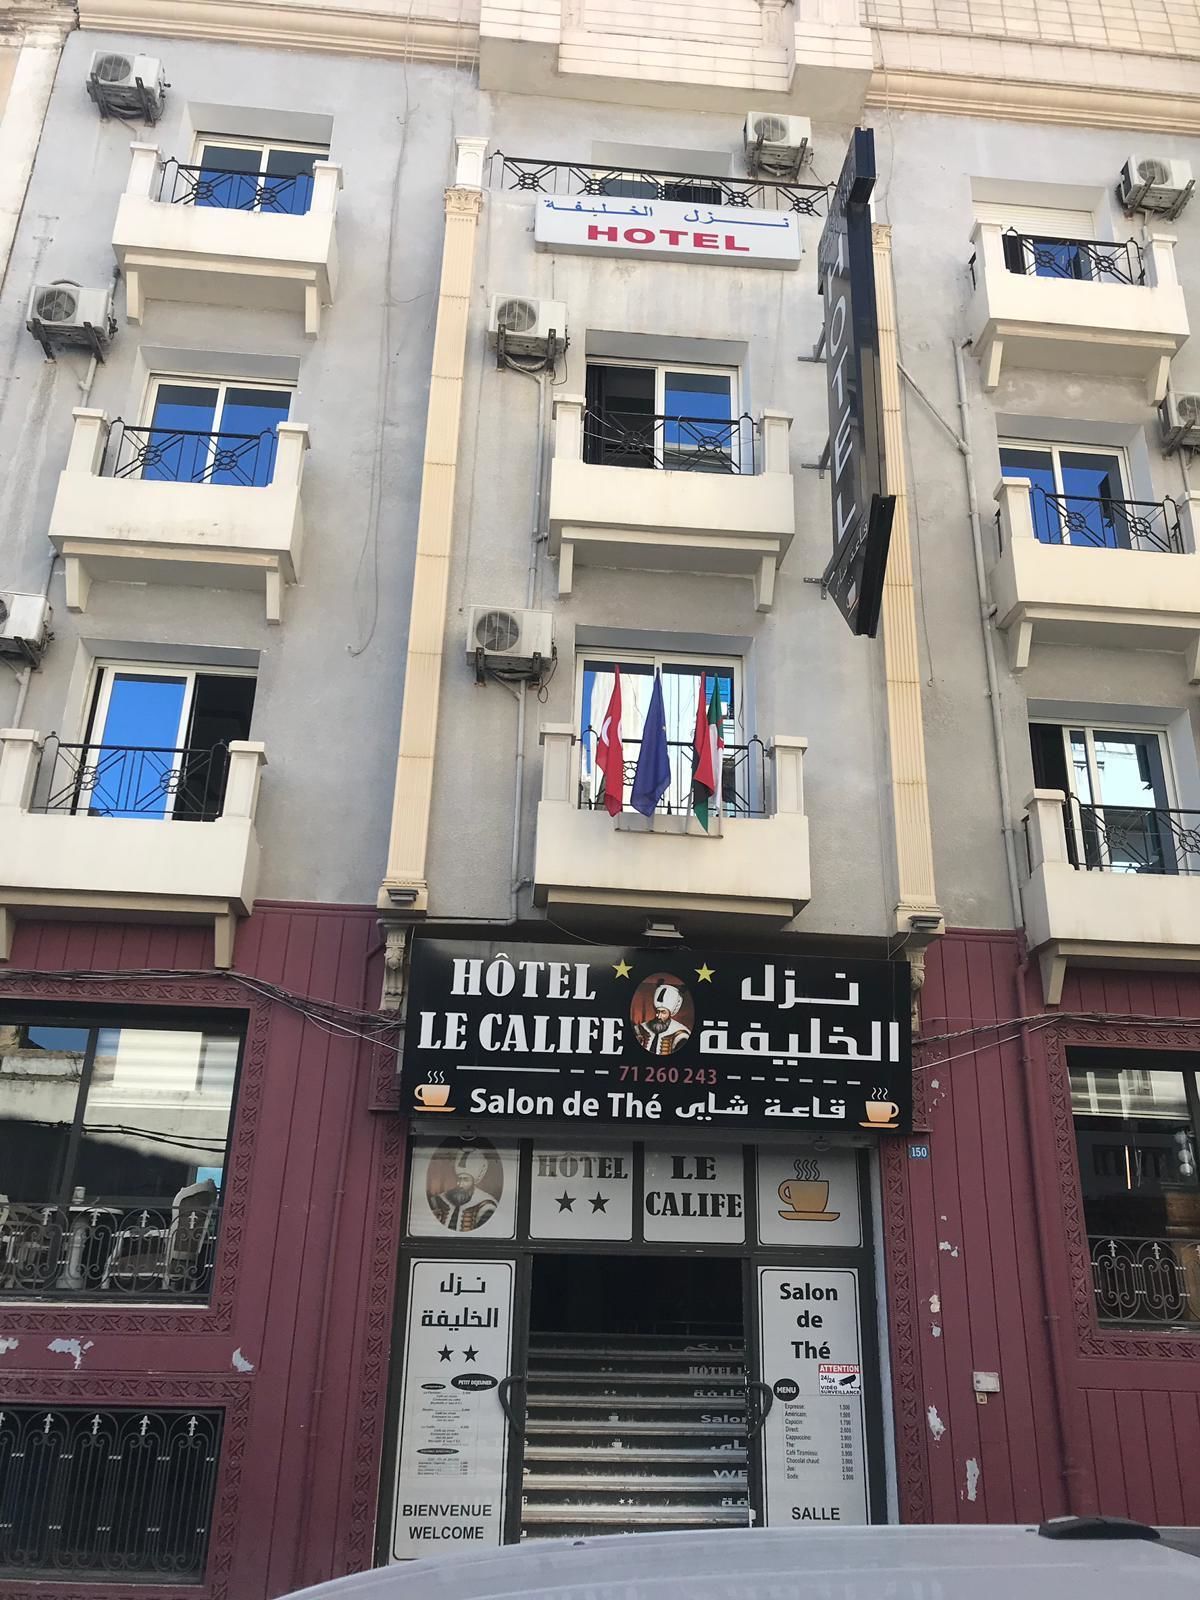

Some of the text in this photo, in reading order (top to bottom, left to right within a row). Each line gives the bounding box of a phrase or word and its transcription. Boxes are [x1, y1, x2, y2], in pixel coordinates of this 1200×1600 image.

[543, 199, 790, 228] نزل الخليفة
[587, 224, 750, 252] HOTEL
[827, 233, 857, 545] HOTEL
[450, 952, 597, 1000] HÔTEL
[741, 964, 860, 1009] نزل
[417, 1011, 625, 1055] LE CALIFE
[699, 1018, 899, 1066] الخليفة
[619, 1065, 718, 1086] 71 260 243
[469, 1087, 663, 1119] Salon de Thé
[675, 1090, 846, 1121] قاعة شاي
[911, 1147, 927, 1158] 150
[537, 1151, 629, 1180] HÔTEL
[671, 1155, 718, 1181] LE
[645, 1190, 744, 1219] CALIFE
[440, 1272, 487, 1297] نزل
[779, 1282, 839, 1301] Salon
[421, 1306, 499, 1331] الخليفة
[796, 1309, 824, 1328] de
[790, 1340, 832, 1360] Thé
[819, 1364, 860, 1373] ATTENTION
[820, 1374, 836, 1384] 24/24
[694, 1388, 746, 1398] خليفة
[776, 1386, 797, 1394] MENU
[402, 1504, 492, 1517] BIENVENUE
[791, 1506, 840, 1521] SALLE
[409, 1526, 484, 1540] WELCOME
